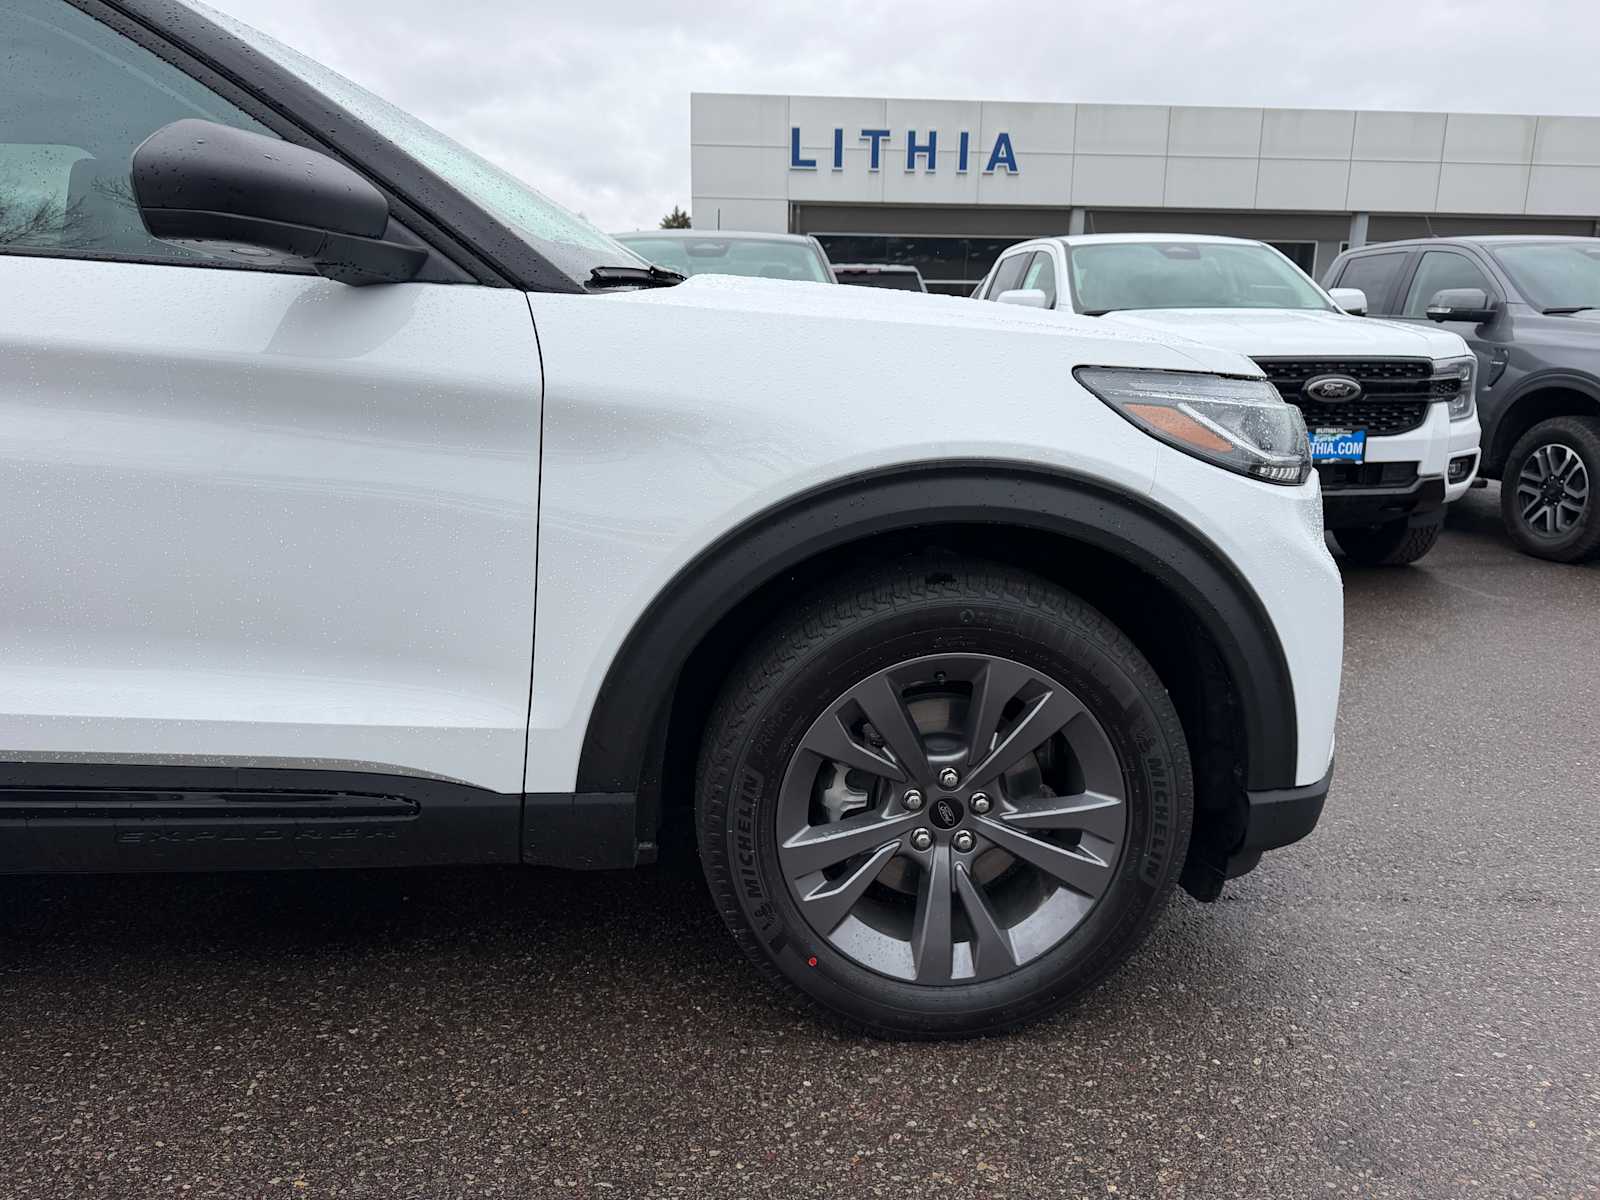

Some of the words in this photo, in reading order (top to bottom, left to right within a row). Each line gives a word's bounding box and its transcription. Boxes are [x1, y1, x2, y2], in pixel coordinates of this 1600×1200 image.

[790, 127, 1018, 173] LITHIA
[1310, 441, 1363, 455] THIA.COM
[738, 774, 763, 898] MICHELIN
[1147, 757, 1168, 880] MICHELIN
